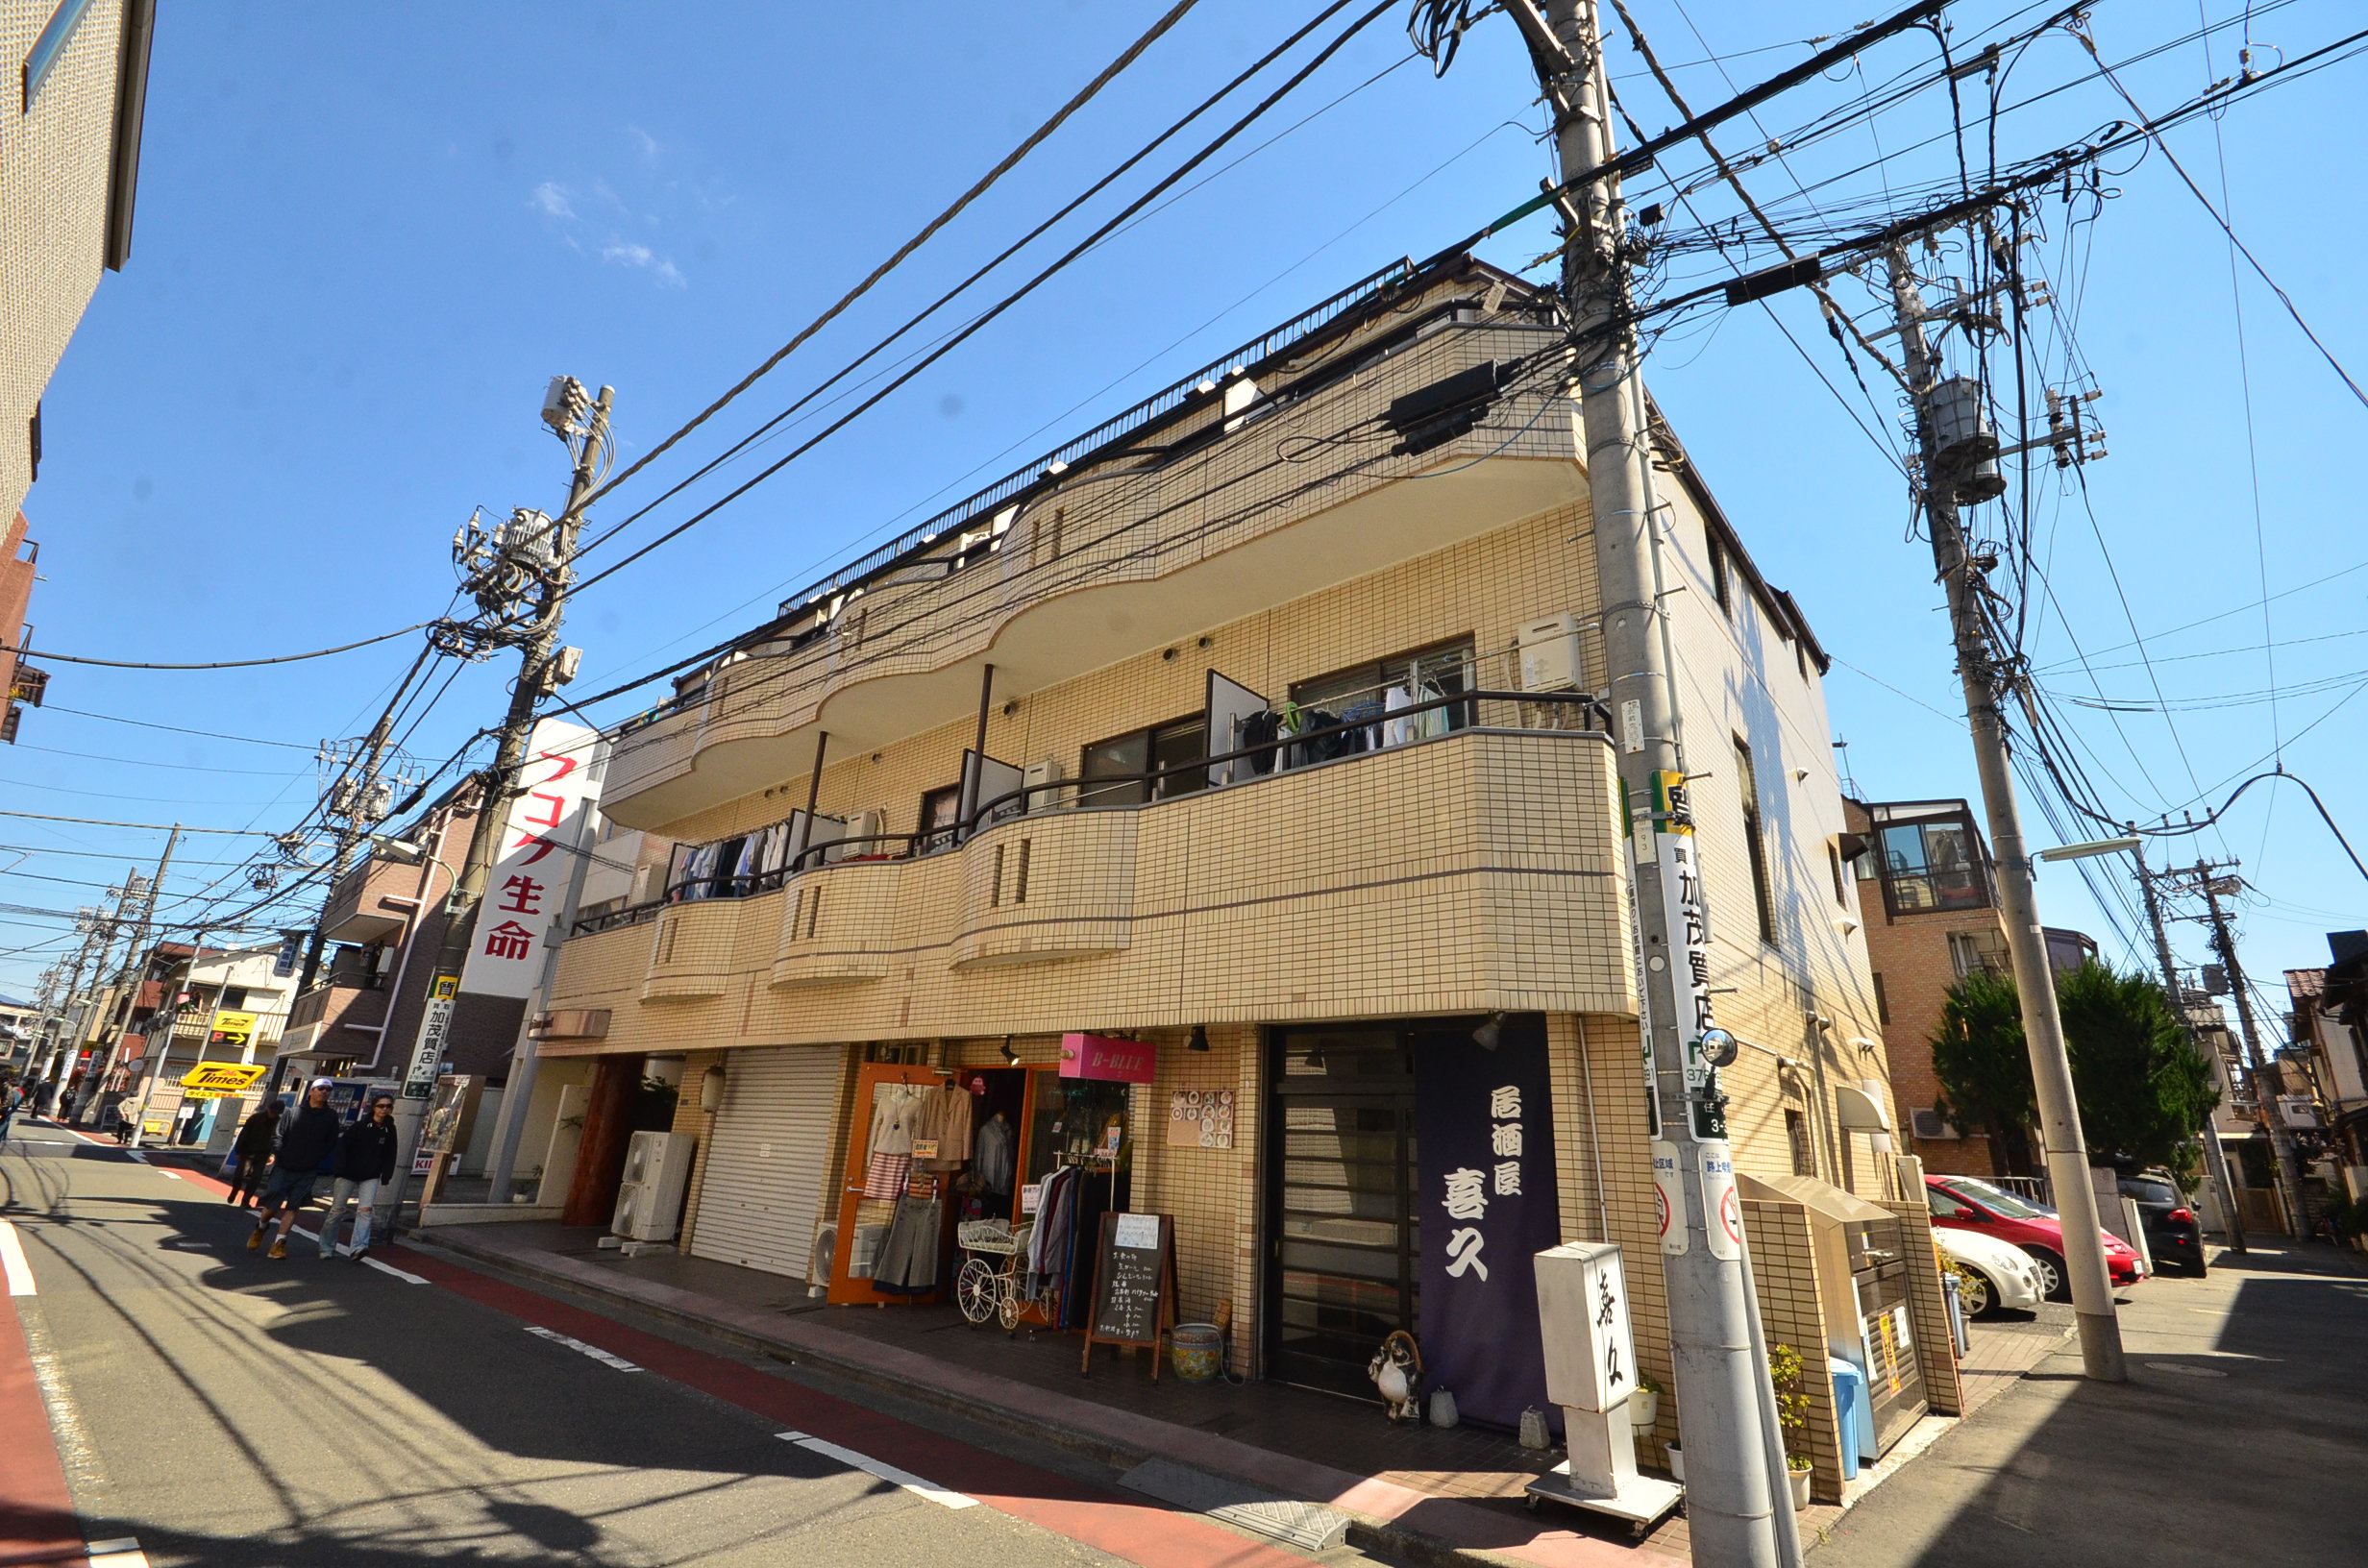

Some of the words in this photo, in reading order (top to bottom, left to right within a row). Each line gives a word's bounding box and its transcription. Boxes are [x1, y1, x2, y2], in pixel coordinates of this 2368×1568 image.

[483, 750, 578, 961] フコク生命
[437, 981, 456, 997] 質
[196, 1068, 248, 1086] Times
[211, 1031, 225, 1043] P
[418, 1010, 446, 1065] 加茂質店
[1490, 1085, 1524, 1197] 居酒屋
[1441, 1166, 1490, 1283] 喜久
[1595, 1268, 1624, 1388] 喜久
